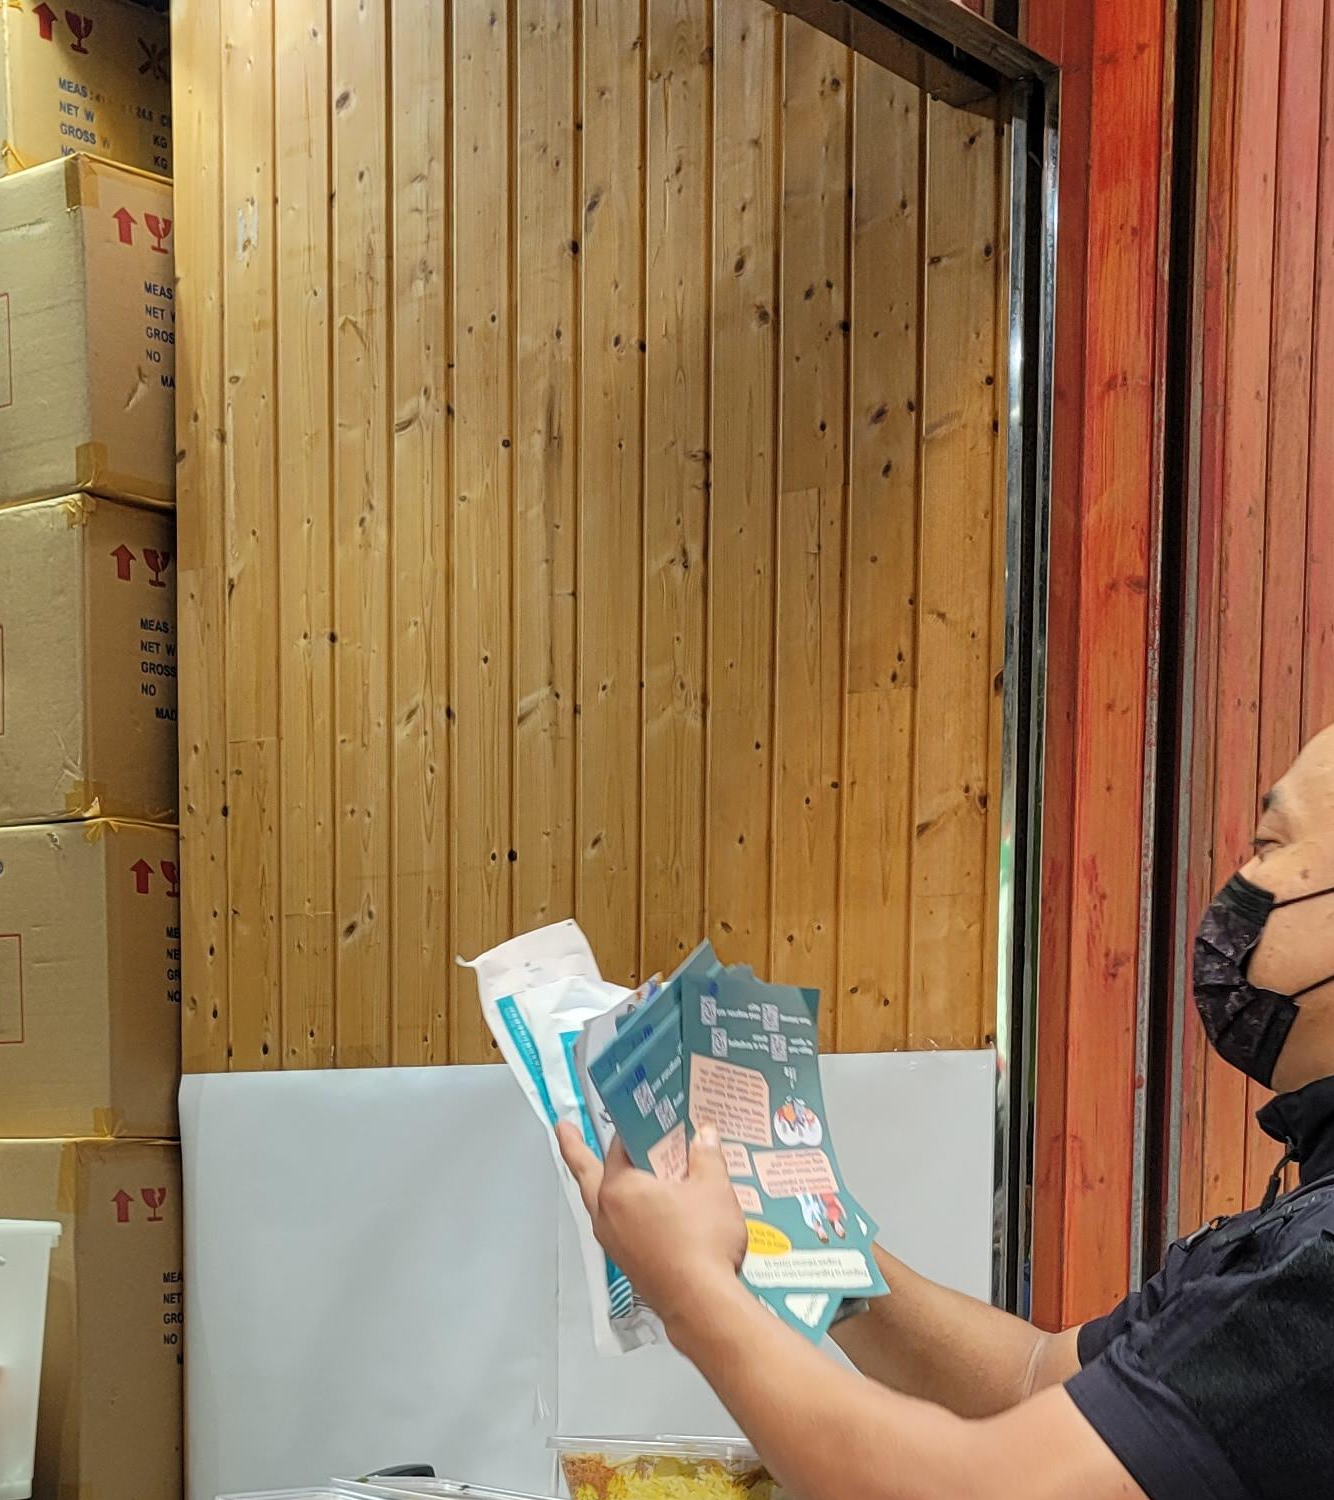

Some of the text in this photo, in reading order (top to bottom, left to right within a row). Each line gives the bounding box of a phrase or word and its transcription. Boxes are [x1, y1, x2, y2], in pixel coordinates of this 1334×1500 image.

[58, 77, 88, 99] MEAS
[59, 102, 80, 120] NET
[59, 123, 97, 146] GROSS
[144, 281, 173, 300] MEAS
[145, 304, 166, 322] NET
[145, 348, 162, 364] NO
[140, 617, 169, 634] MEAS
[140, 639, 161, 655] NET
[141, 682, 157, 697] NO
[163, 1333, 179, 1345] NO
